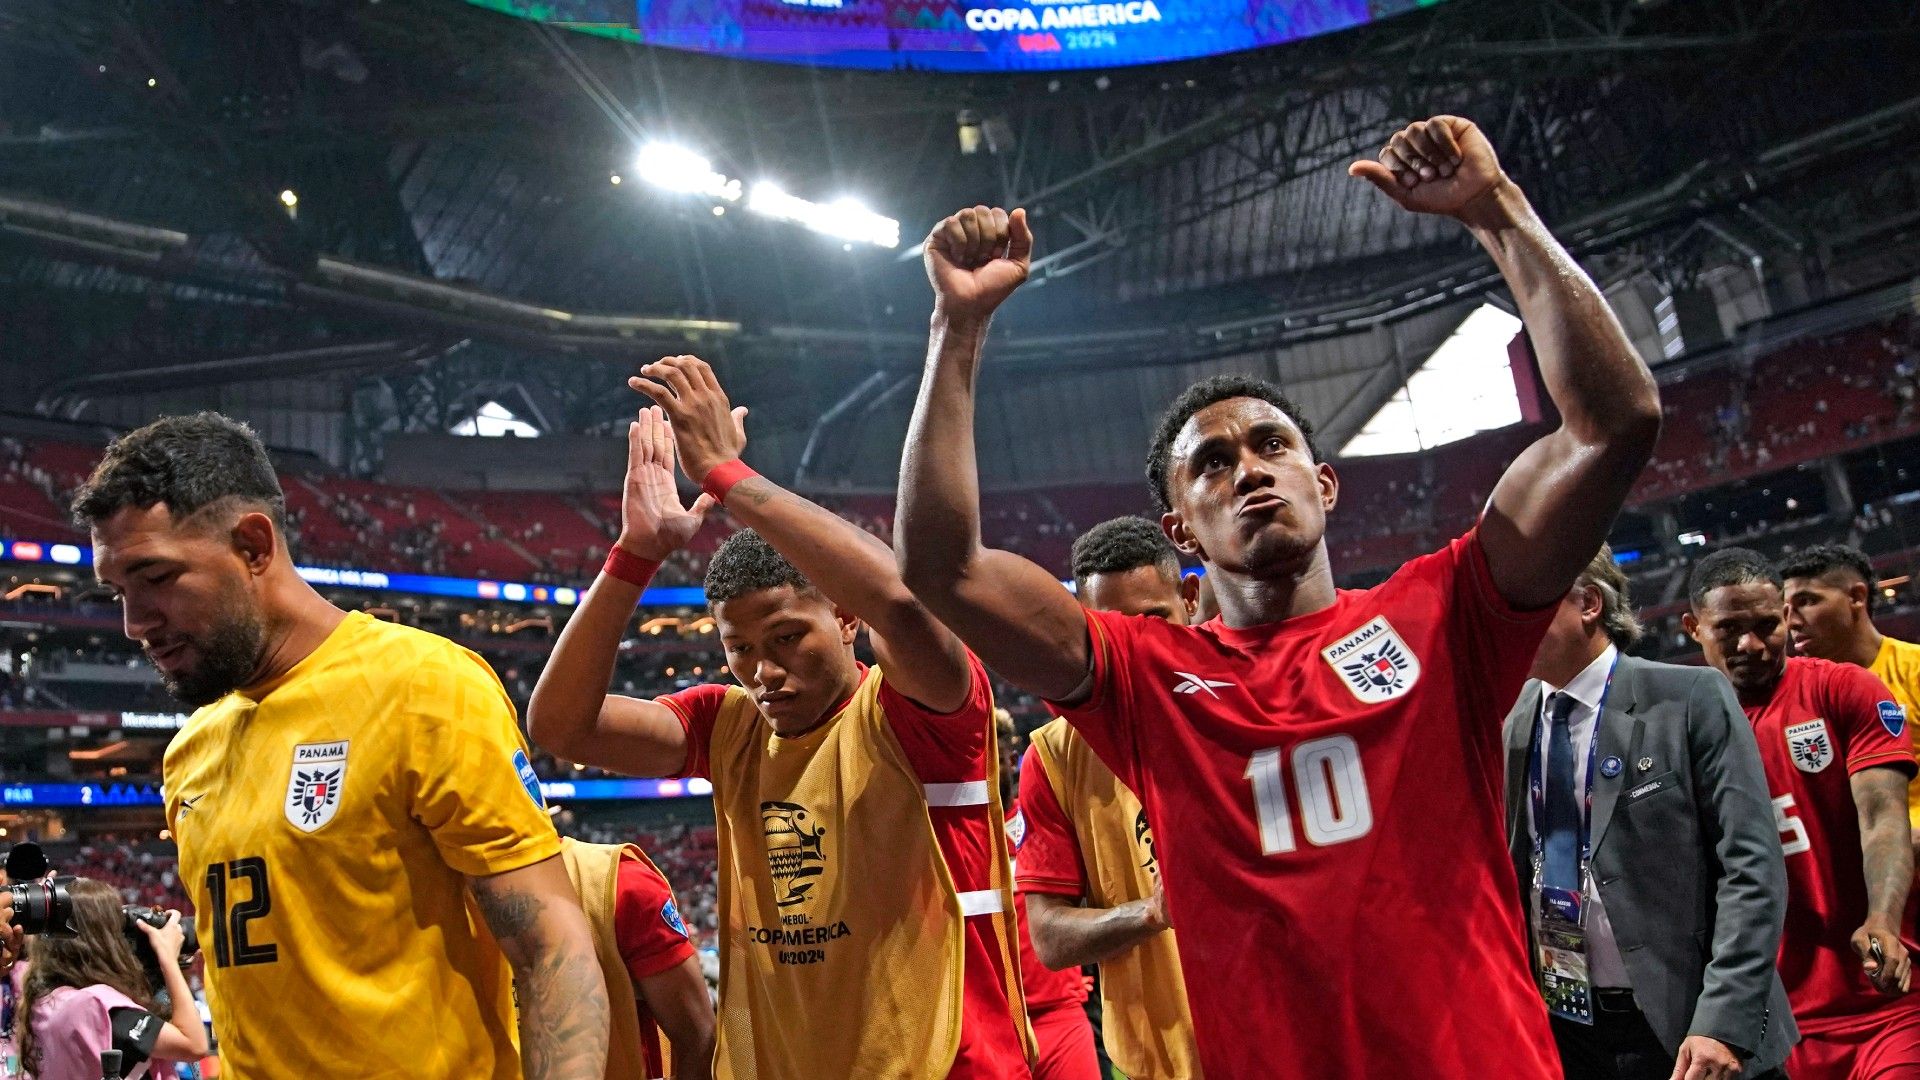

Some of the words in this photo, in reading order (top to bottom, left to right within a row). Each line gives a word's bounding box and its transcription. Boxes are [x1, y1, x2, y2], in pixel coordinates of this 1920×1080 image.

[965, 8, 1039, 31] COPA
[1041, 1, 1161, 29] AMERICA
[1017, 32, 1062, 51] USA
[1066, 31, 1117, 49] 2024
[80, 785, 93, 805] 2
[1242, 732, 1374, 857] 10
[205, 855, 279, 969] 12
[1580, 1009, 1588, 1017] 10
